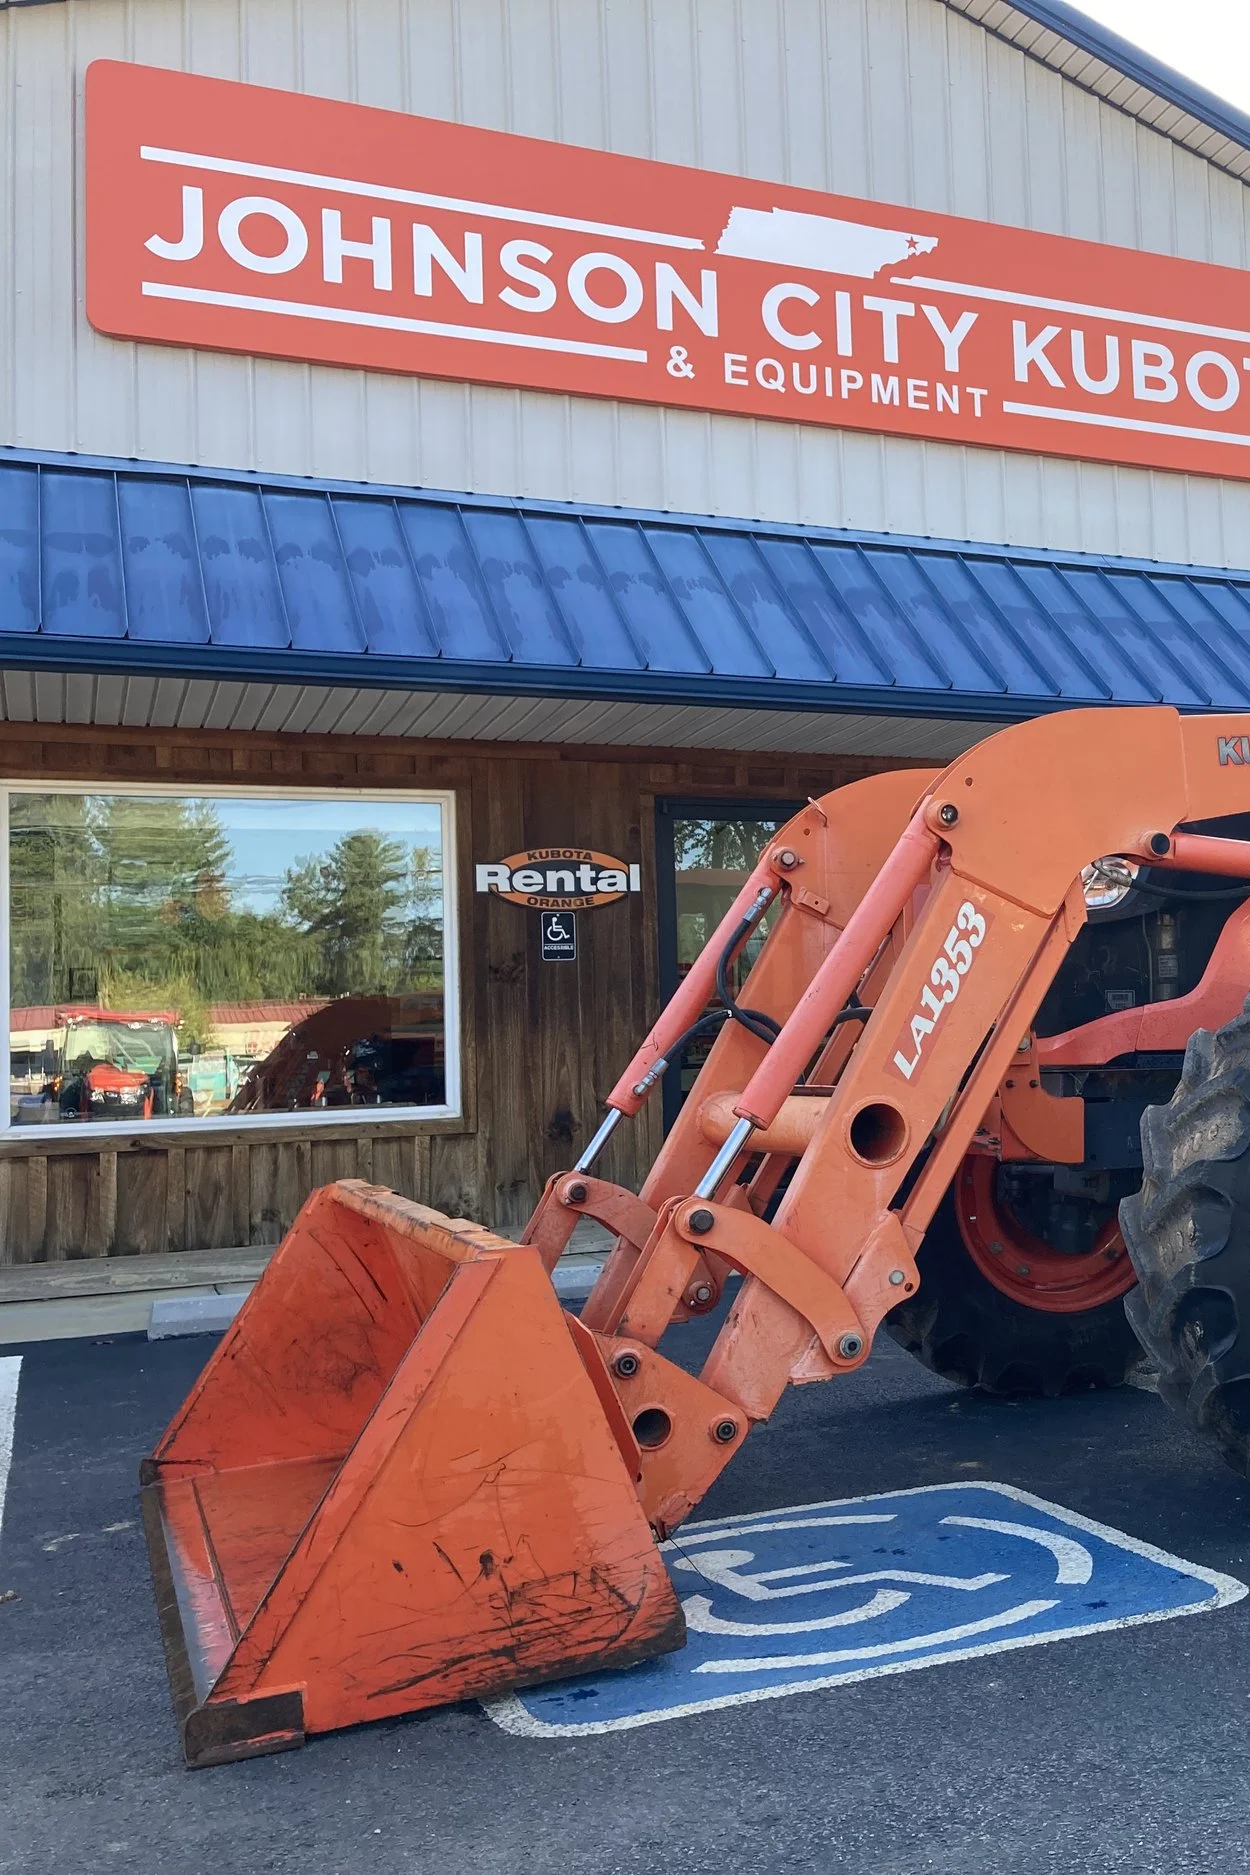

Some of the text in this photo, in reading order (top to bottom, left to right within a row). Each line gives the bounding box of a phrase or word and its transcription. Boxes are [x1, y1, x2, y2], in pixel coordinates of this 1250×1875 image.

[143, 185, 718, 337] JOHNSON
[761, 282, 979, 373] CITY
[666, 345, 989, 418] & EQUIPMENT
[475, 864, 641, 893] Rental
[526, 850, 593, 861] KUBOTA
[526, 896, 595, 908] ORANGE
[893, 901, 986, 1079] LA1353
